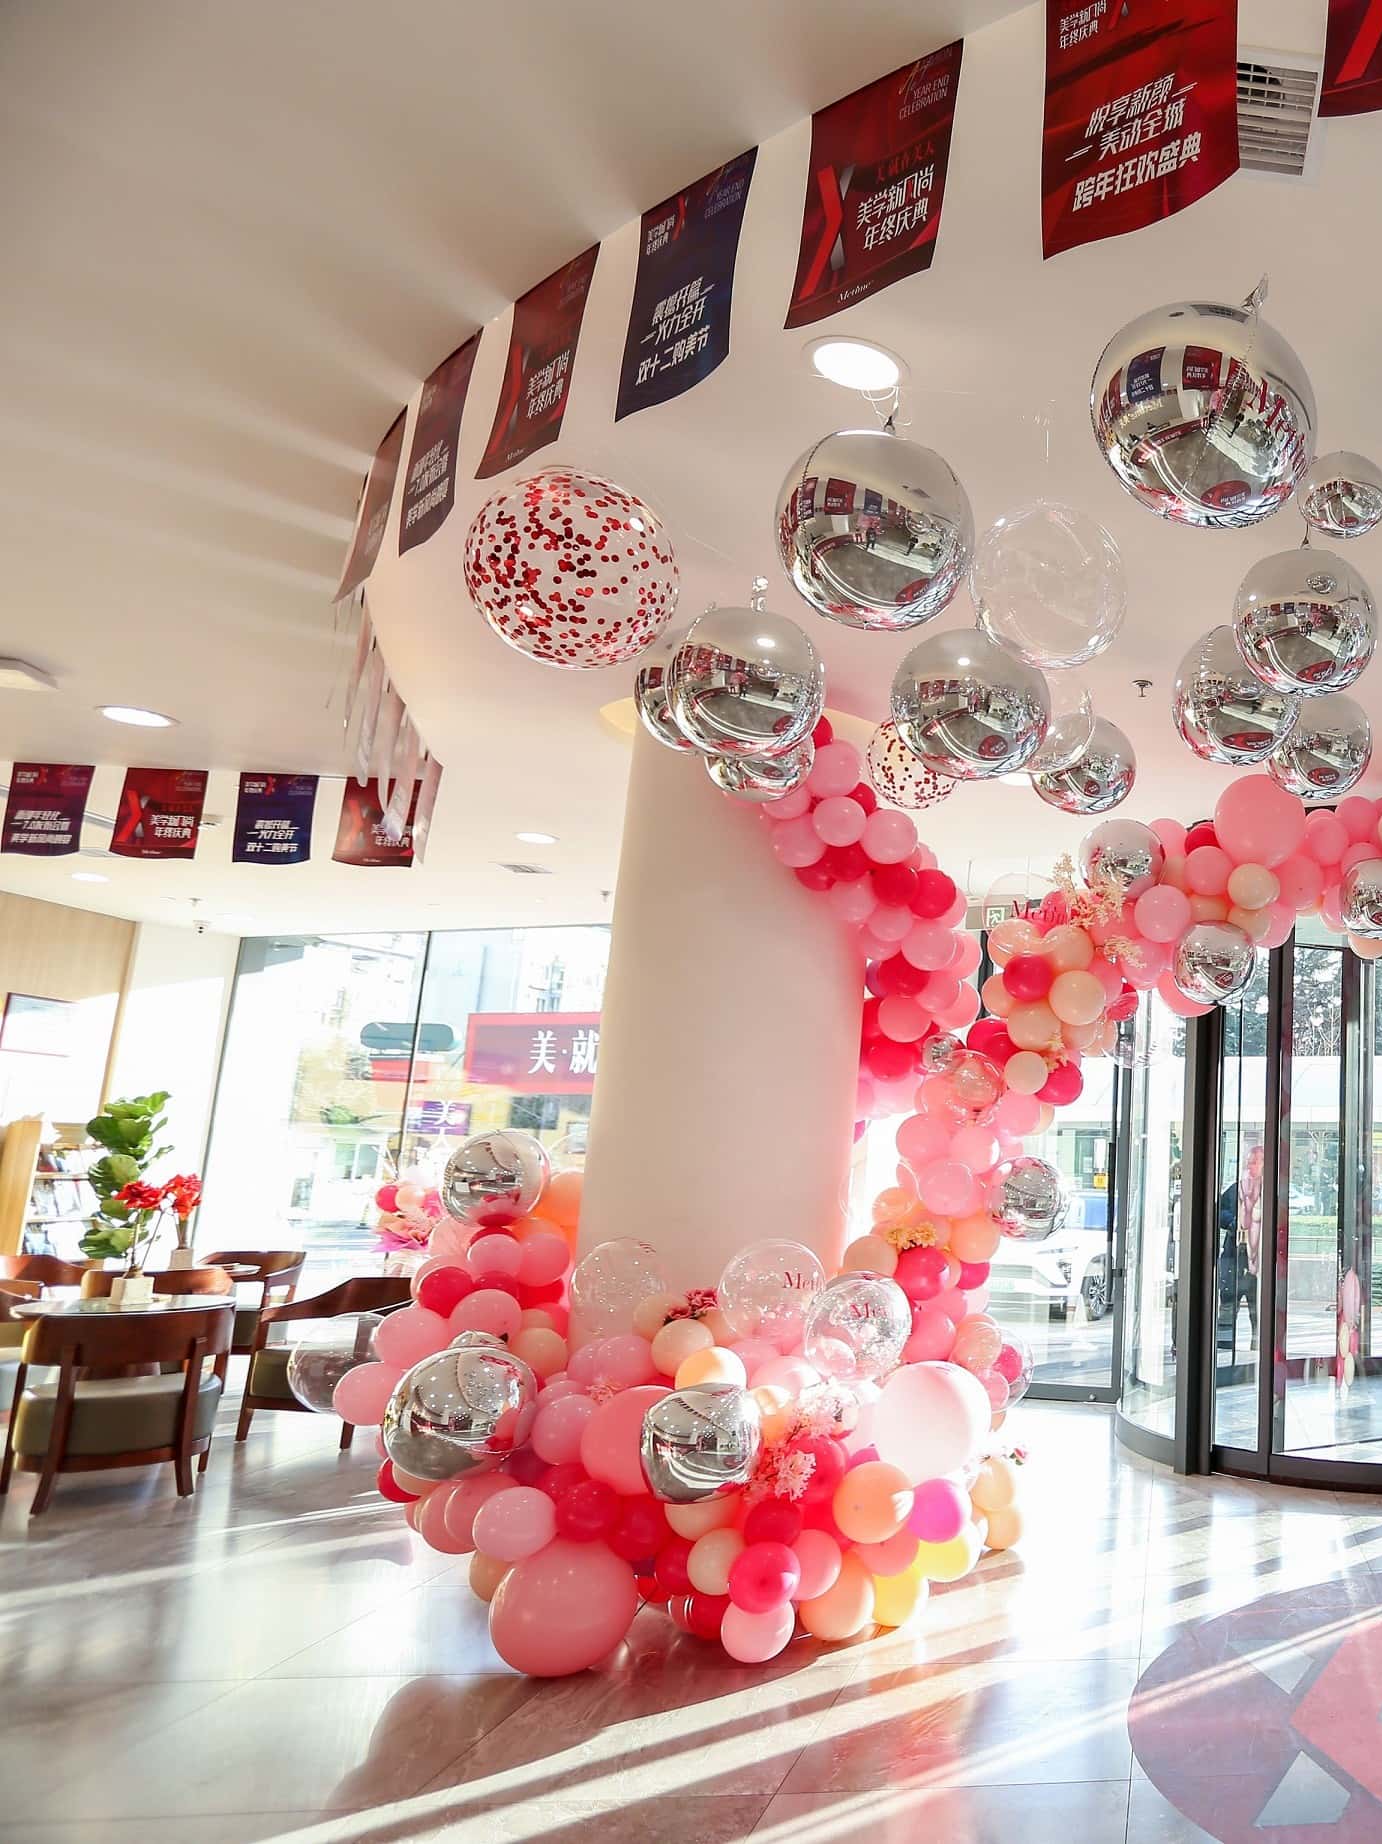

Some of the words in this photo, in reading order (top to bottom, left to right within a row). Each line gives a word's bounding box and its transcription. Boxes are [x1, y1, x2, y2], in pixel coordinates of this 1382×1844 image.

[1099, 96, 1186, 160] 美动全城
[1072, 131, 1201, 212] 跨年狂欢盛典
[863, 197, 929, 251] 年终庆典
[655, 296, 707, 345] 火力全开
